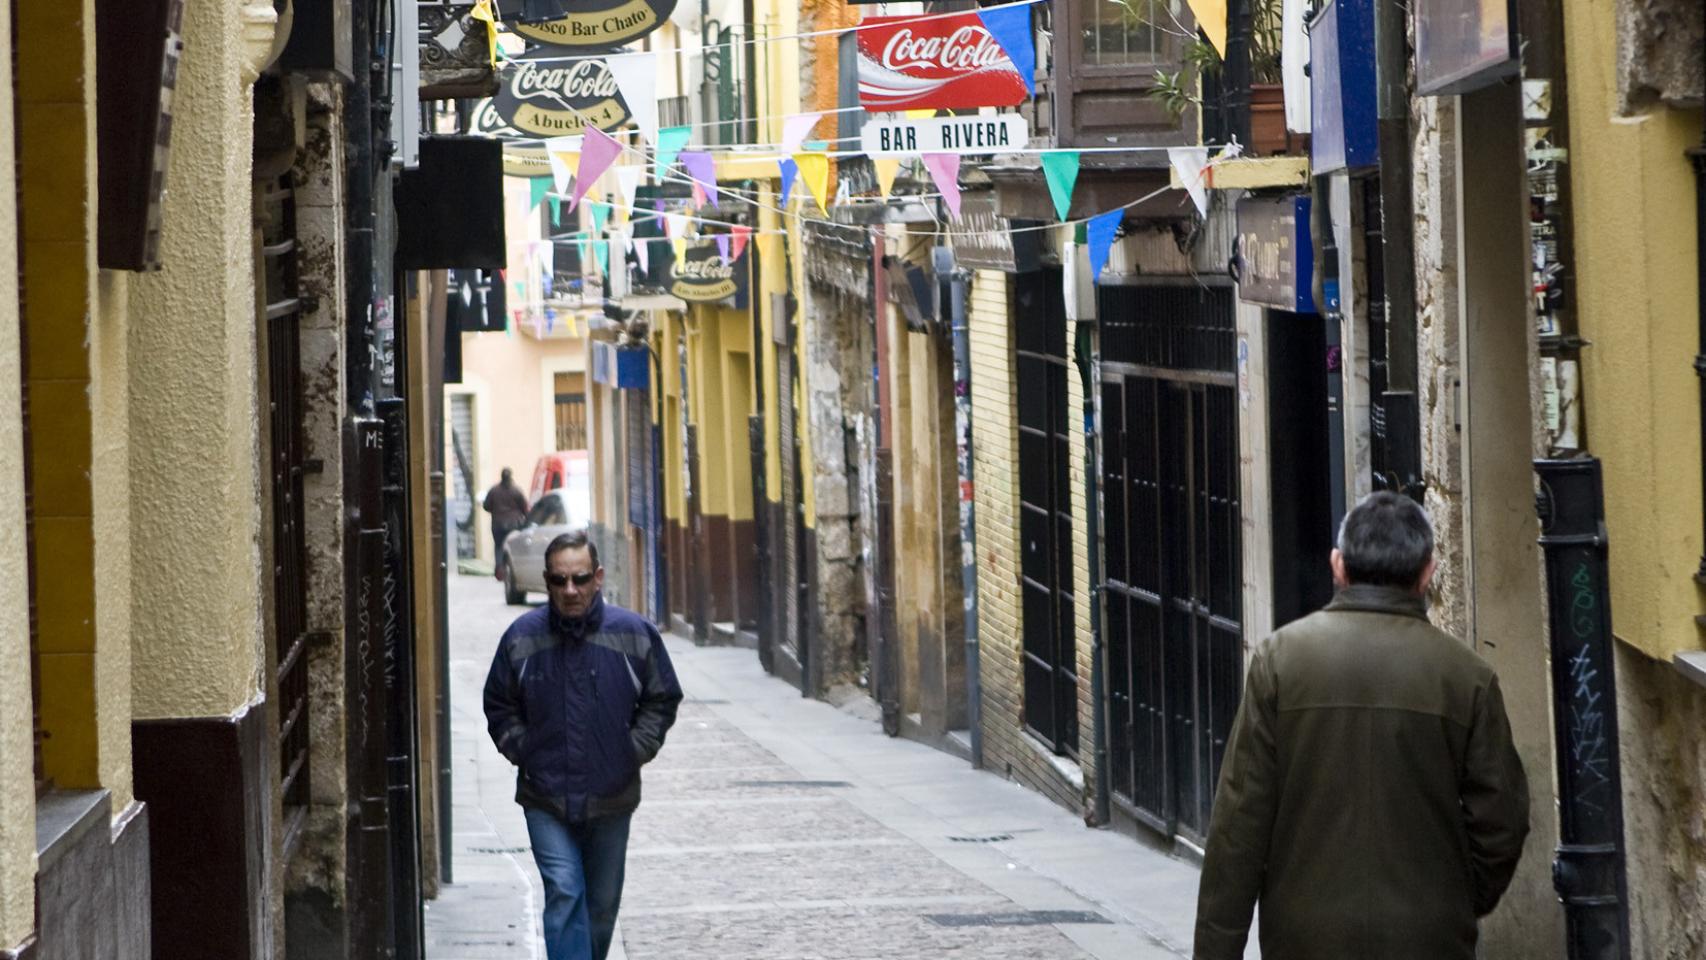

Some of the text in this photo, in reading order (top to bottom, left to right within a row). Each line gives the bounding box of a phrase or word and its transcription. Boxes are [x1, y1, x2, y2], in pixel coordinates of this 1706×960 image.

[572, 21, 599, 36] Bar
[602, 9, 647, 34] Chato
[601, 107, 613, 120] 4
[880, 121, 1009, 151] BAR RIVERA
